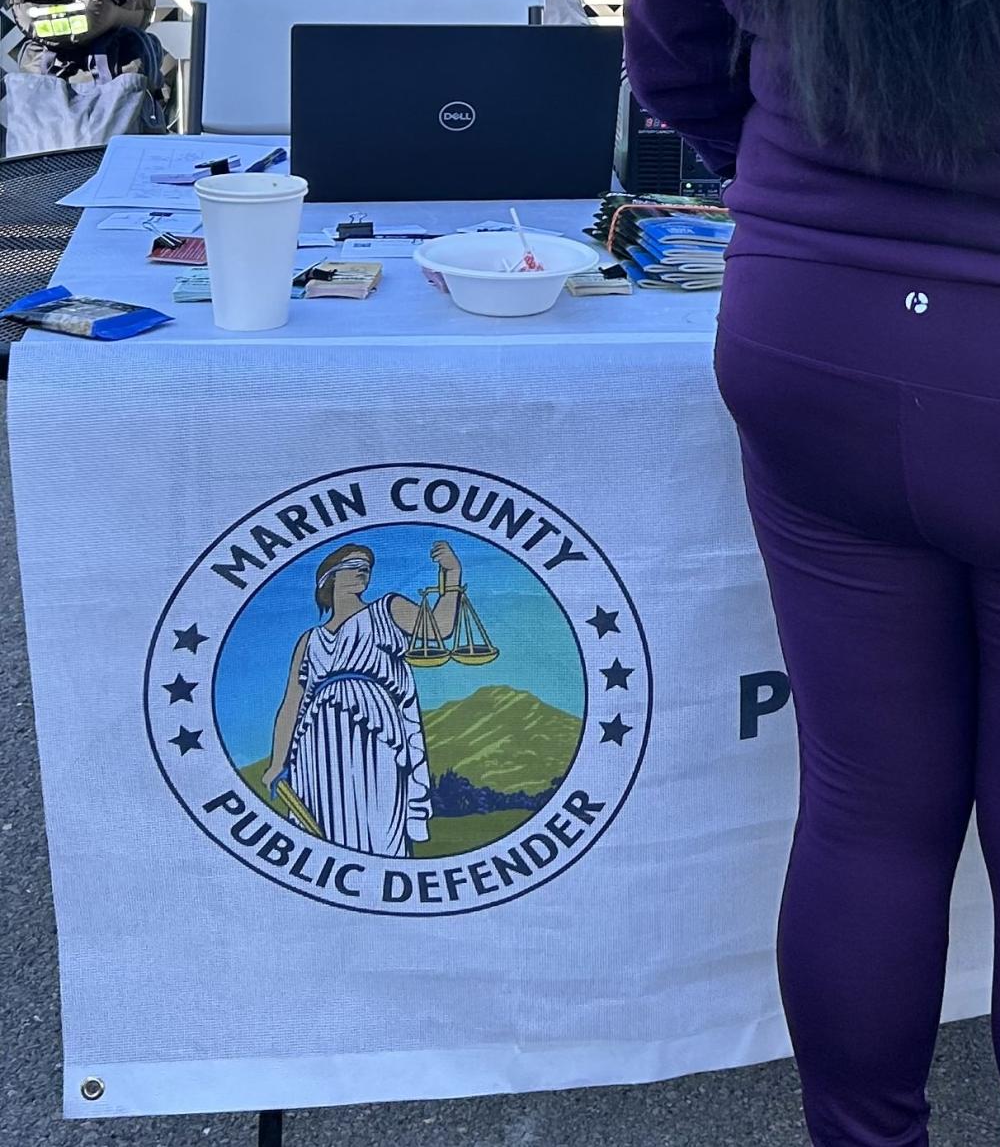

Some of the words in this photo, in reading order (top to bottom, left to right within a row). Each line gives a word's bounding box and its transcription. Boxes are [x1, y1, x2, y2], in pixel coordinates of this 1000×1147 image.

[444, 112, 472, 121] DELL
[211, 483, 368, 590] MARIN
[390, 478, 588, 571] COUNTY
[202, 790, 366, 897] PUBLIC
[382, 789, 607, 903] DEFENDER
